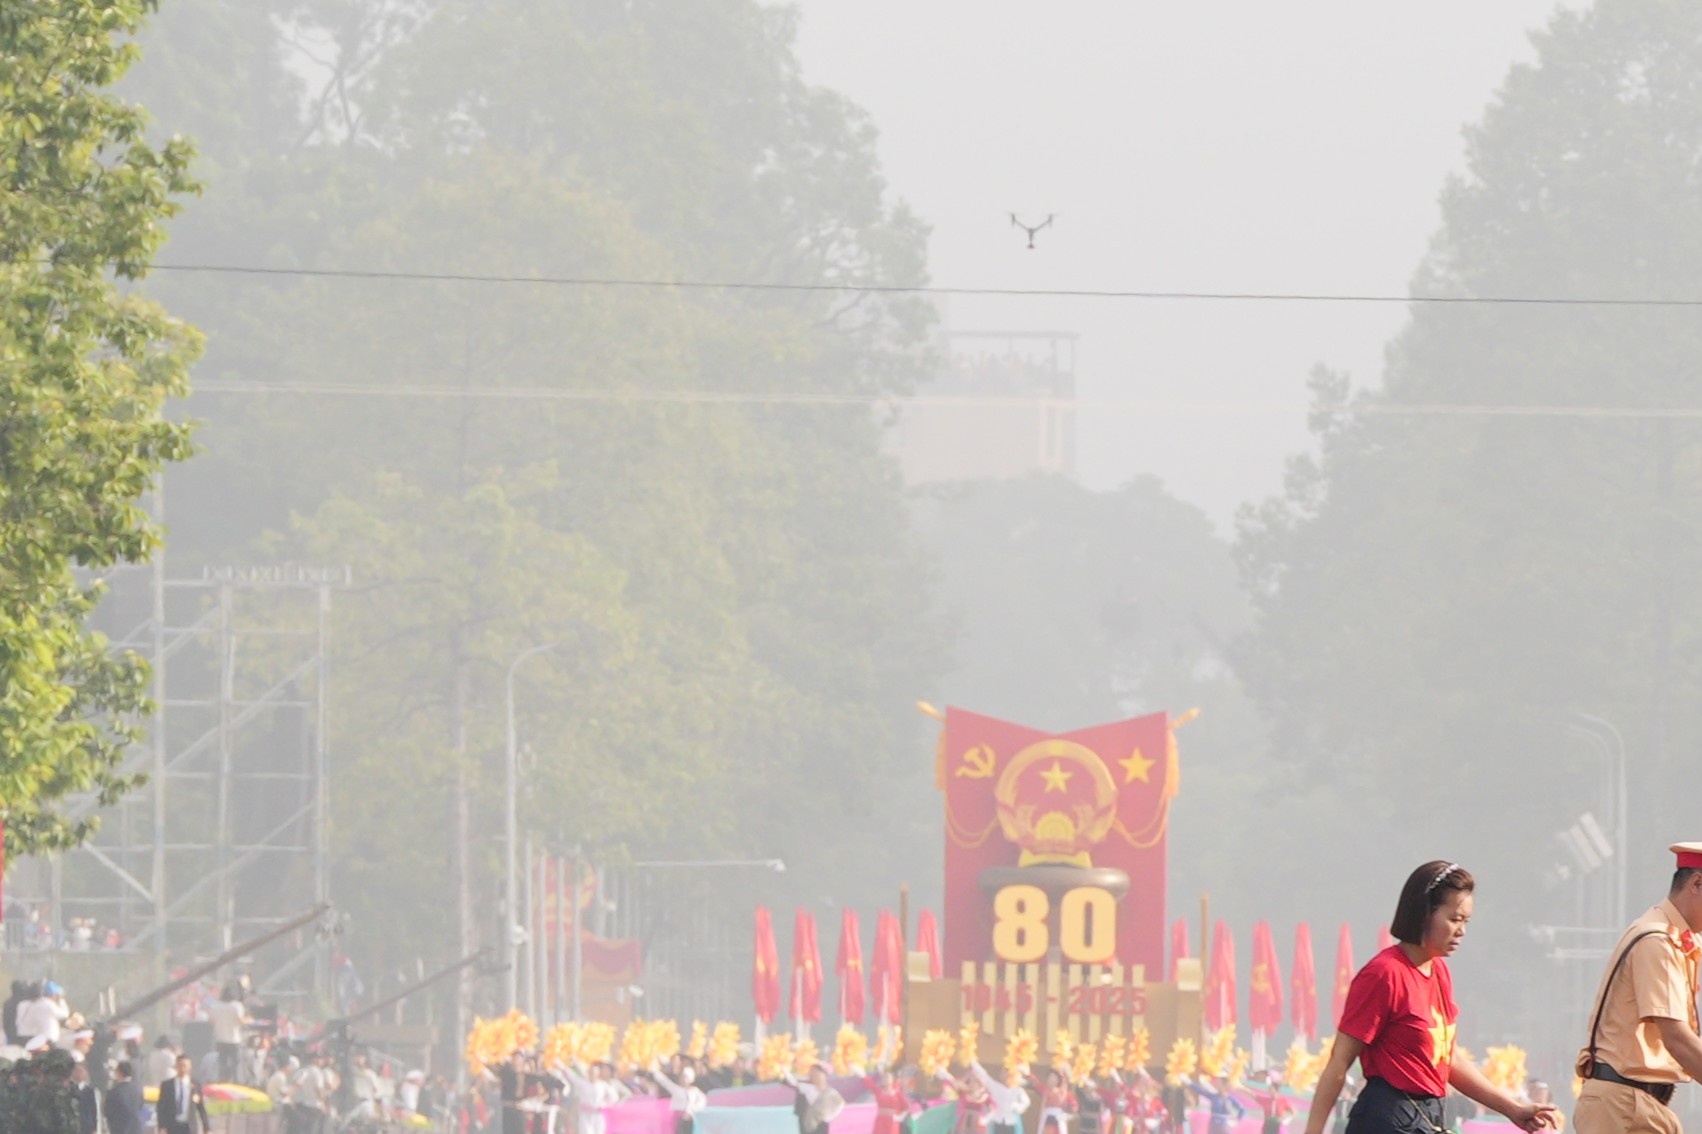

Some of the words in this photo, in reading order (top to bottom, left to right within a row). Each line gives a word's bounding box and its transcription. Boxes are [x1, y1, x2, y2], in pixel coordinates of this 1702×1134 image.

[992, 884, 1117, 962] 80
[961, 983, 1033, 1013] 1945
[1069, 985, 1149, 1016] 2025
